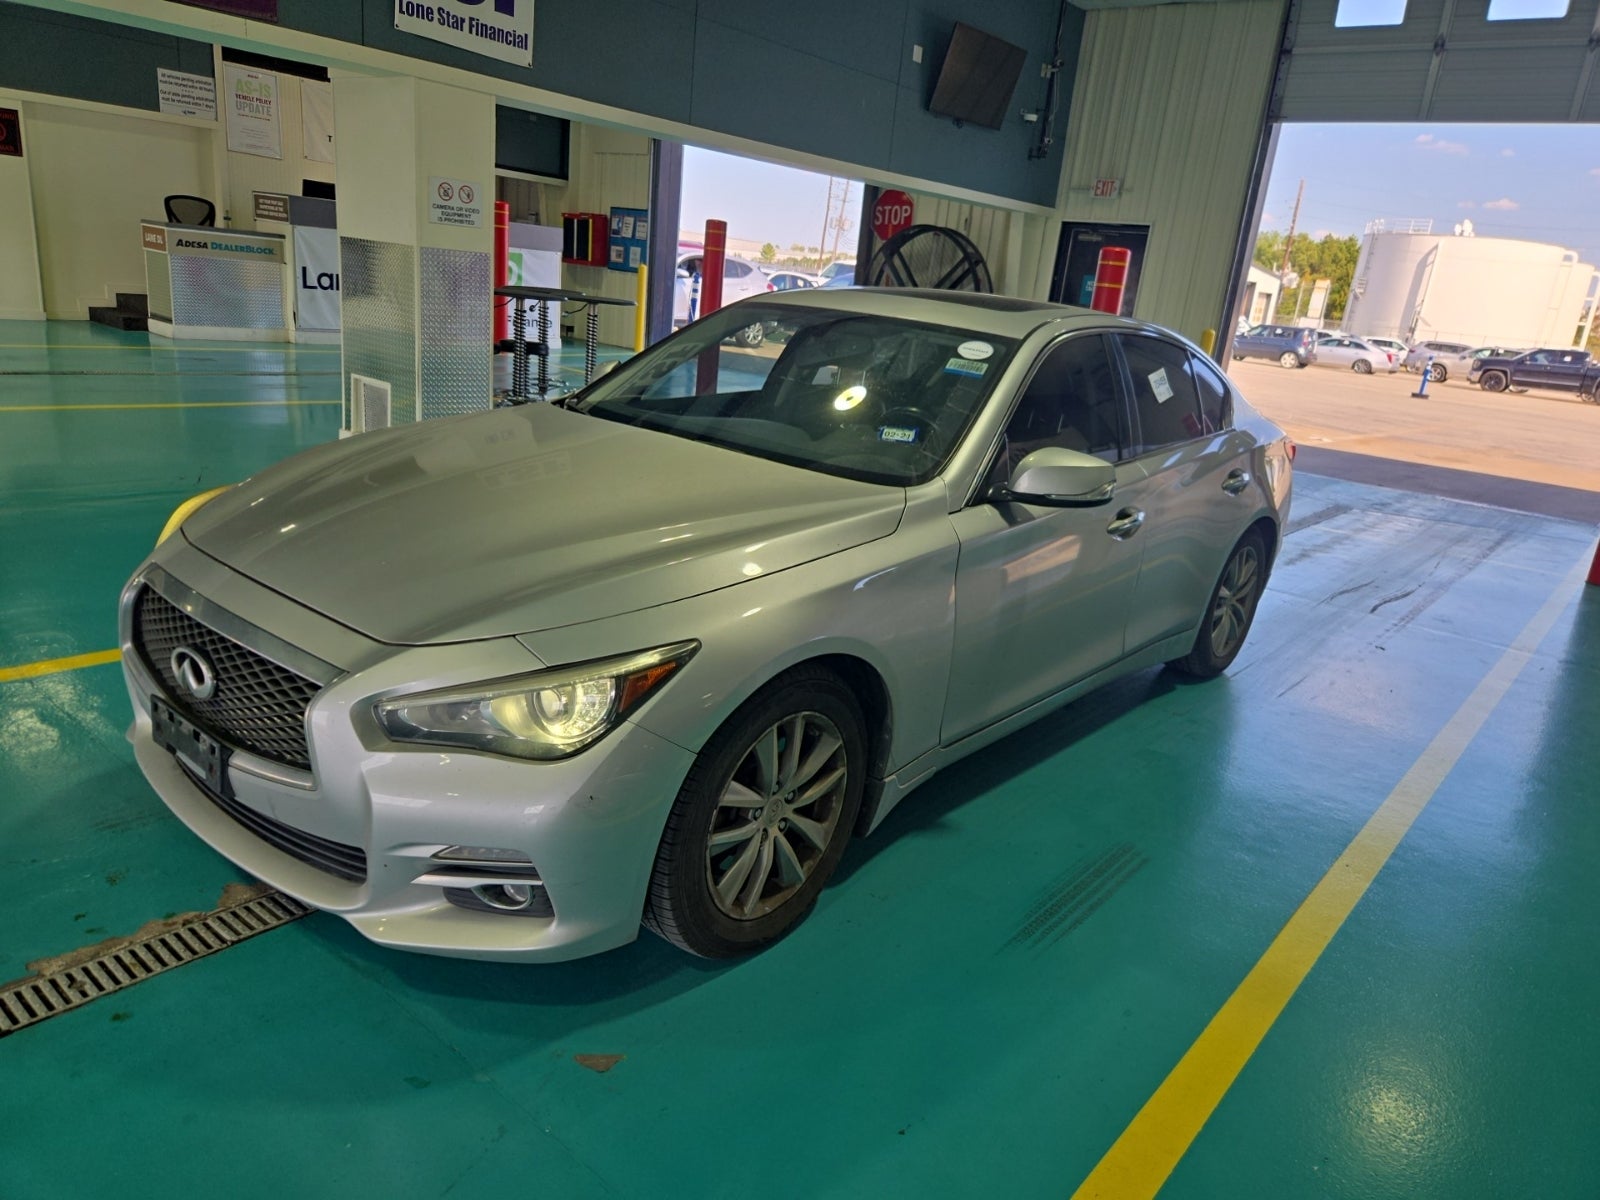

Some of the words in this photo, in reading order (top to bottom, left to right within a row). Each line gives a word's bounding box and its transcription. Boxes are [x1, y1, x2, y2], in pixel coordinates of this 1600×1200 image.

[399, 0, 435, 22] Lone
[437, 6, 466, 32] Star
[468, 16, 529, 51] Financial
[236, 78, 272, 99] AS-IS
[235, 93, 255, 103] VEHICLE
[255, 97, 272, 105] POLICY
[235, 100, 272, 117] UPDATE
[1094, 179, 1116, 197] EXIT
[432, 202, 455, 211] CAMERA
[441, 210, 472, 219] EQUIPMENT
[874, 205, 911, 225] STOP
[443, 217, 475, 226] PROHIBITED
